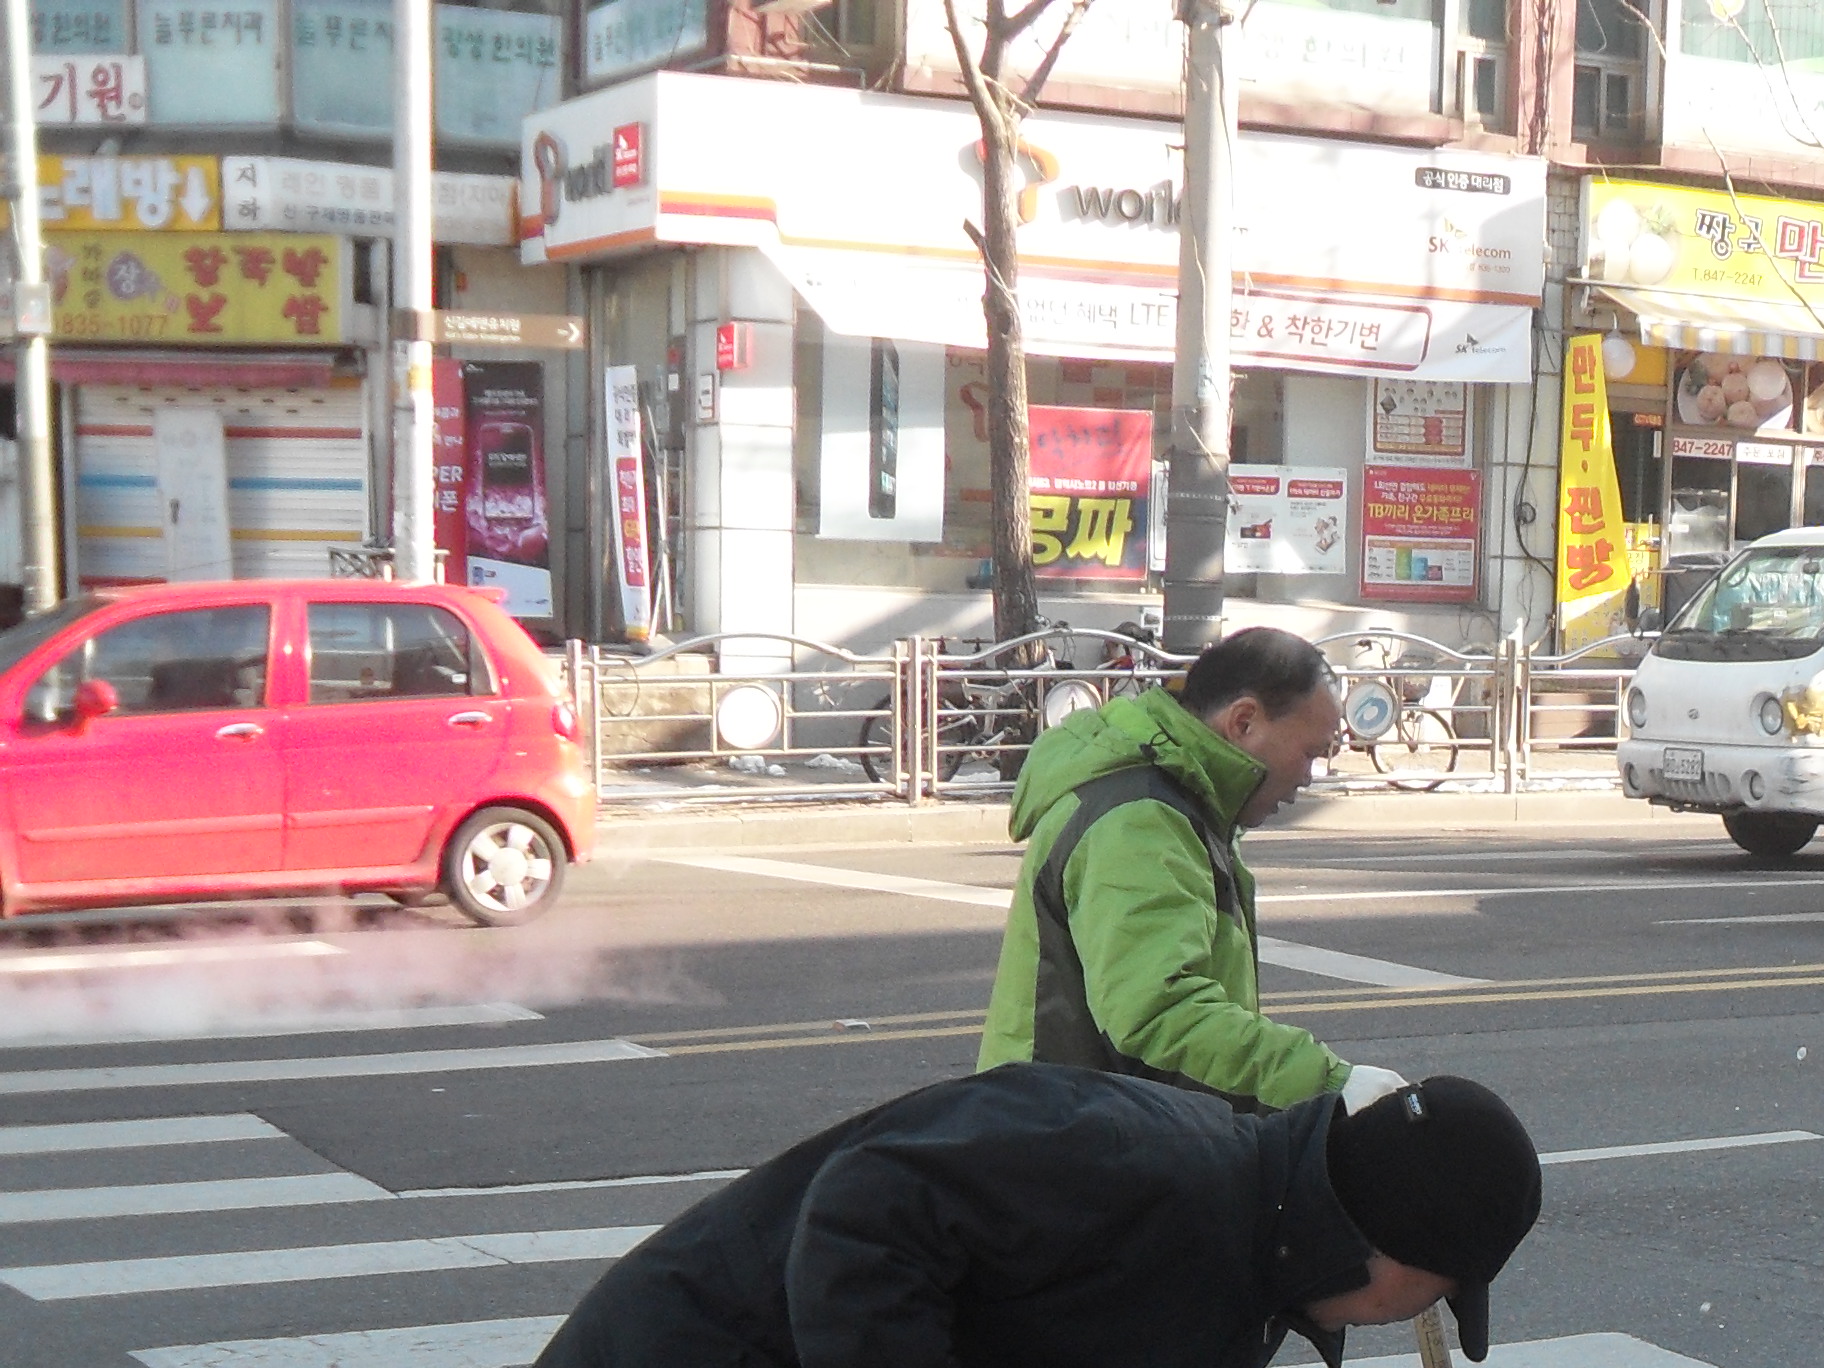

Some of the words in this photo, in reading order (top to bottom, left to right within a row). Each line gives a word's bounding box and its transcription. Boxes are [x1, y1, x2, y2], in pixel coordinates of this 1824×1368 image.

[38, 62, 127, 122] 기원
[1422, 170, 1446, 188] 공식
[1447, 171, 1470, 190] 인증
[1471, 174, 1505, 194] 대리점
[1428, 236, 1449, 254] SK
[1076, 300, 1120, 330] 혜택
[1129, 302, 1171, 328] LTE
[1284, 314, 1383, 352] 착한기변
[1673, 440, 1733, 457] 847-2247
[1412, 505, 1475, 524] 온가족프리
